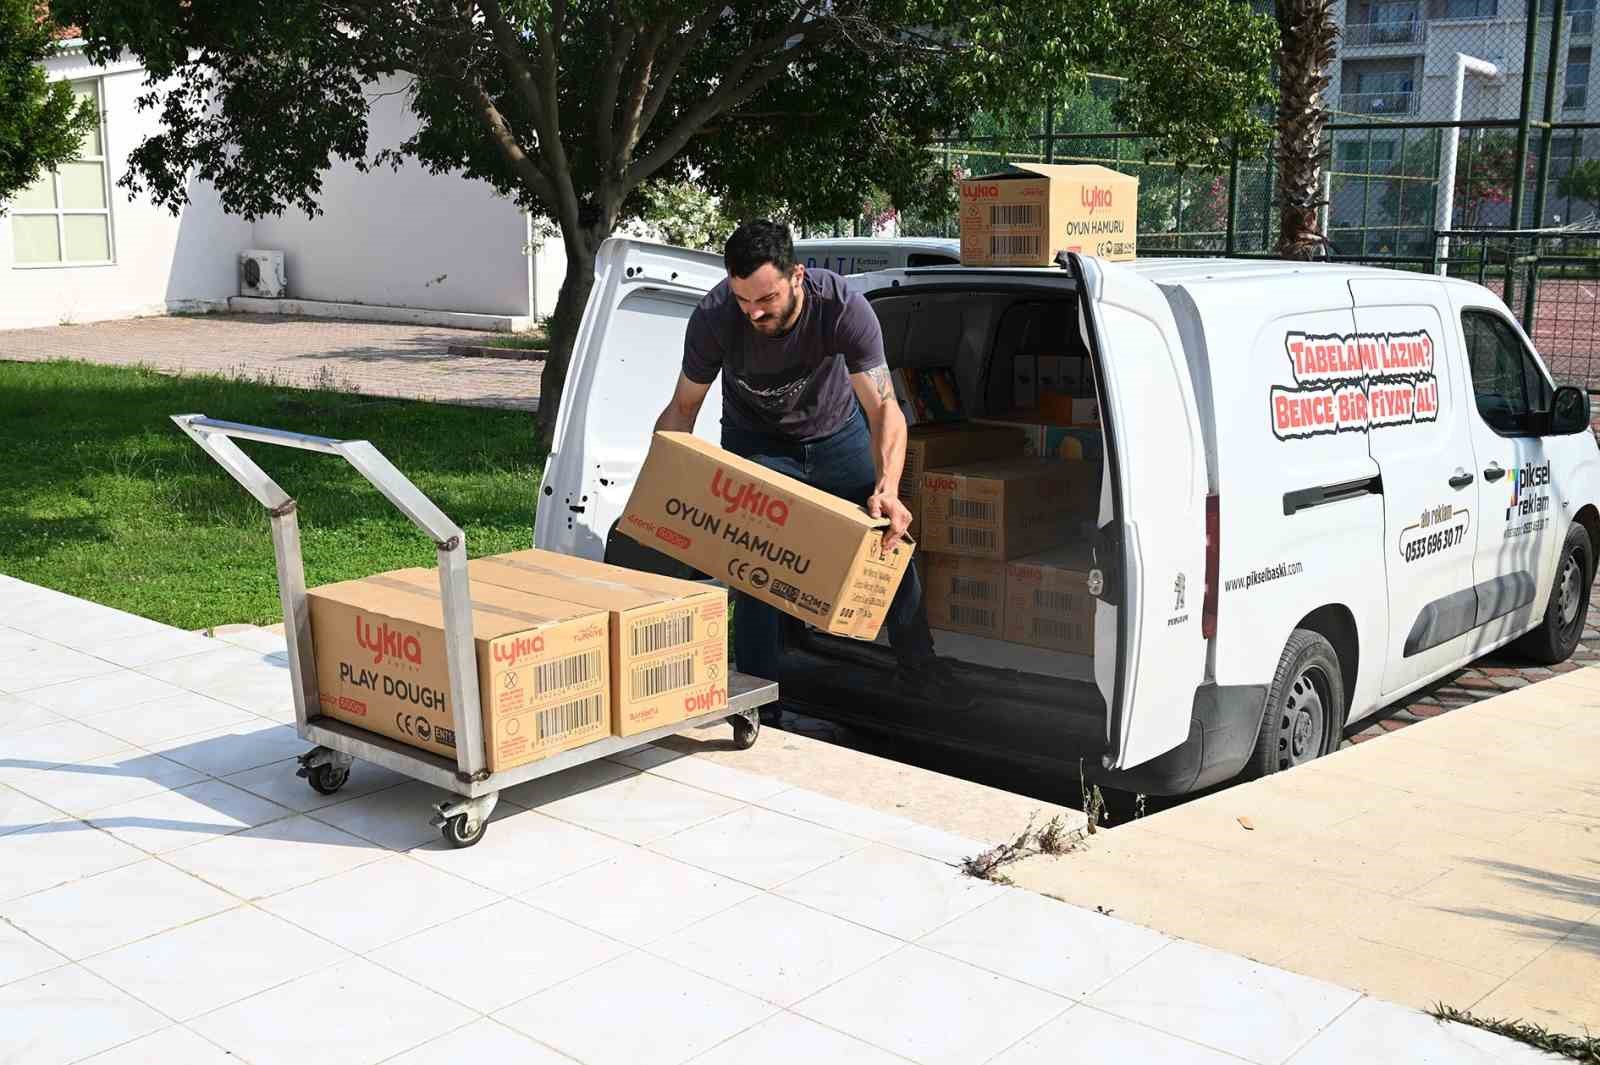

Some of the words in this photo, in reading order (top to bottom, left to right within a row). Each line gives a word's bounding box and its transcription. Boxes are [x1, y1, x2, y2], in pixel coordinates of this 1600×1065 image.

[1066, 220, 1090, 236] OYUN
[1091, 220, 1124, 236] HAMURU
[1381, 339, 1431, 369] LAZIM?
[1275, 395, 1335, 429] BENCE
[1416, 384, 1437, 412] AL!
[1519, 460, 1551, 496] piksel
[1431, 503, 1453, 526] reklam
[1518, 493, 1550, 517] reklam
[665, 498, 721, 535] OYUN
[722, 524, 811, 574] HAMURU
[1405, 537, 1427, 563] 0533
[1427, 531, 1443, 556] 696
[1443, 527, 1454, 550] 30
[1454, 524, 1464, 545] 77
[339, 662, 379, 692] PLAY
[383, 676, 446, 713] DOUGH
